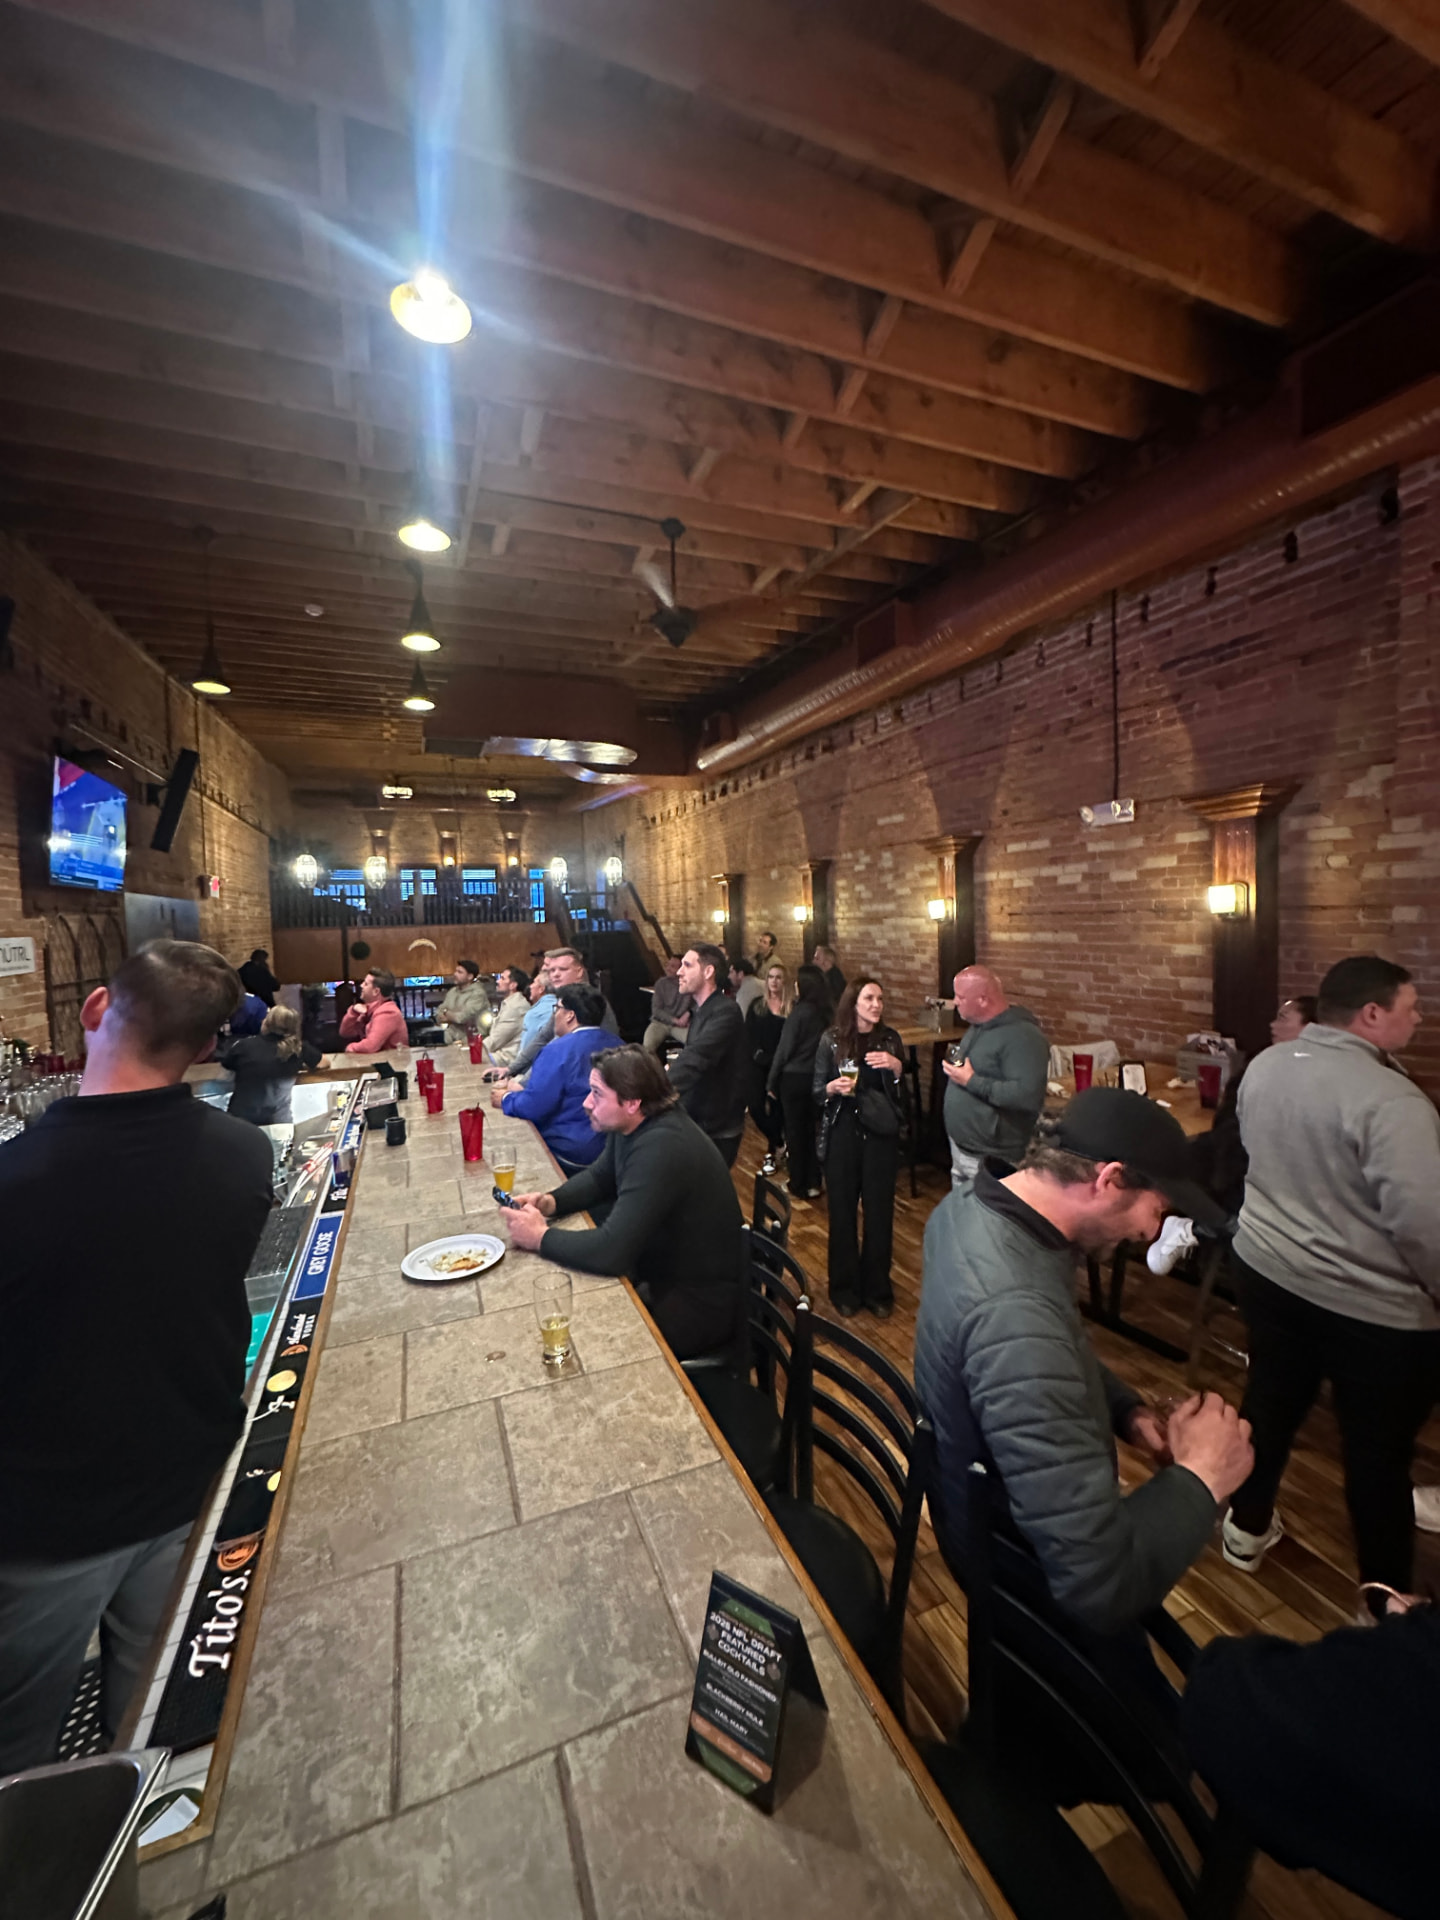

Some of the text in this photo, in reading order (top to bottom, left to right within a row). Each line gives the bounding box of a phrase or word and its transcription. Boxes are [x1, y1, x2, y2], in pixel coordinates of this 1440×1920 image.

[717, 1638, 766, 1677] COCKTAILS
[720, 1629, 765, 1665] FEATURED
[731, 1625, 748, 1642] NFL
[750, 1637, 781, 1664] DRAFT
[705, 1681, 745, 1714] BLACKBERRY
[740, 1673, 776, 1703] FASHIONED
[730, 1718, 748, 1737] MARY
